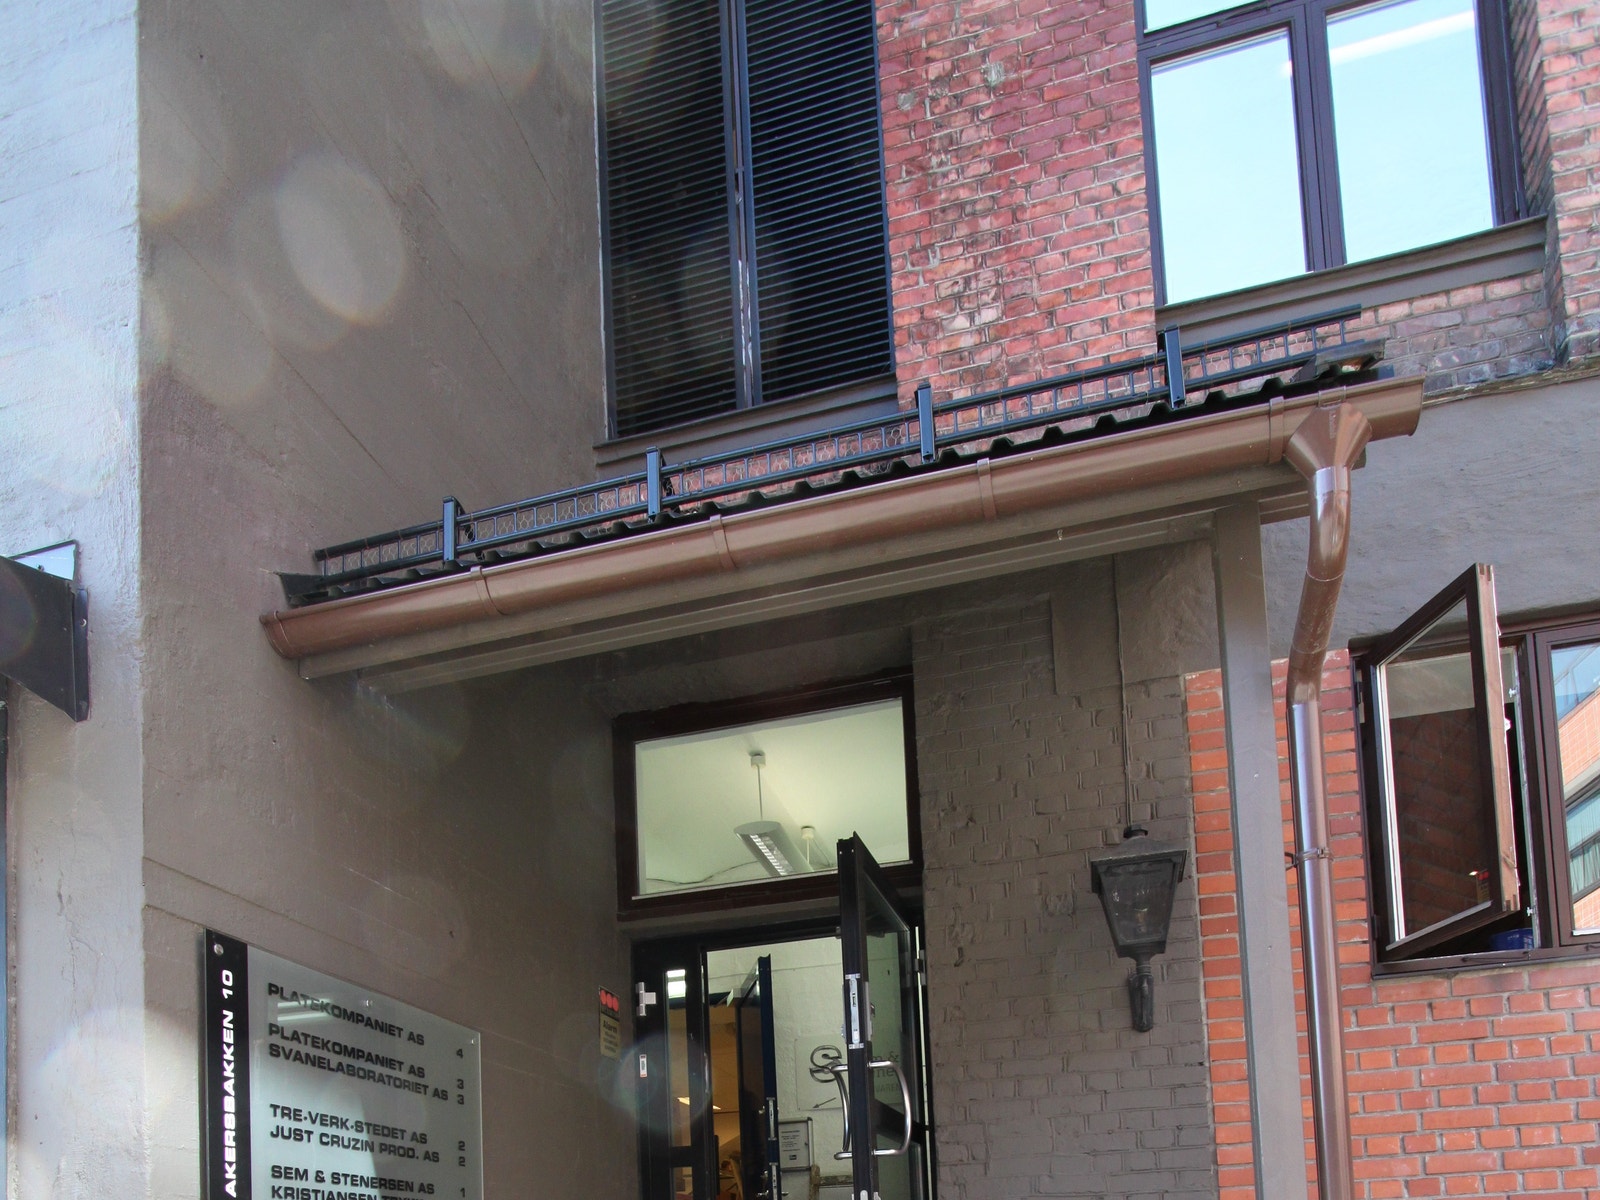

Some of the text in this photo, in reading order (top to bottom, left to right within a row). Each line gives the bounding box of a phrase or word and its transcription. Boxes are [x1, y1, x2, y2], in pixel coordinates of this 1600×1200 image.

[267, 982, 464, 1059] PLATEKOMPANIET AS 4
[222, 969, 237, 1198] AKERSBAKKEN 10
[268, 1022, 465, 1090] PLATEKOMPANIET AS 3
[269, 1043, 465, 1105] SVANELABORATORIET AS 3
[270, 1125, 466, 1167] JUST CRUZIN PROD. AS 2
[410, 1131, 428, 1145] AS
[458, 1140, 466, 1151] 2
[271, 1164, 466, 1198] SEM & STENERSEN AS 1
